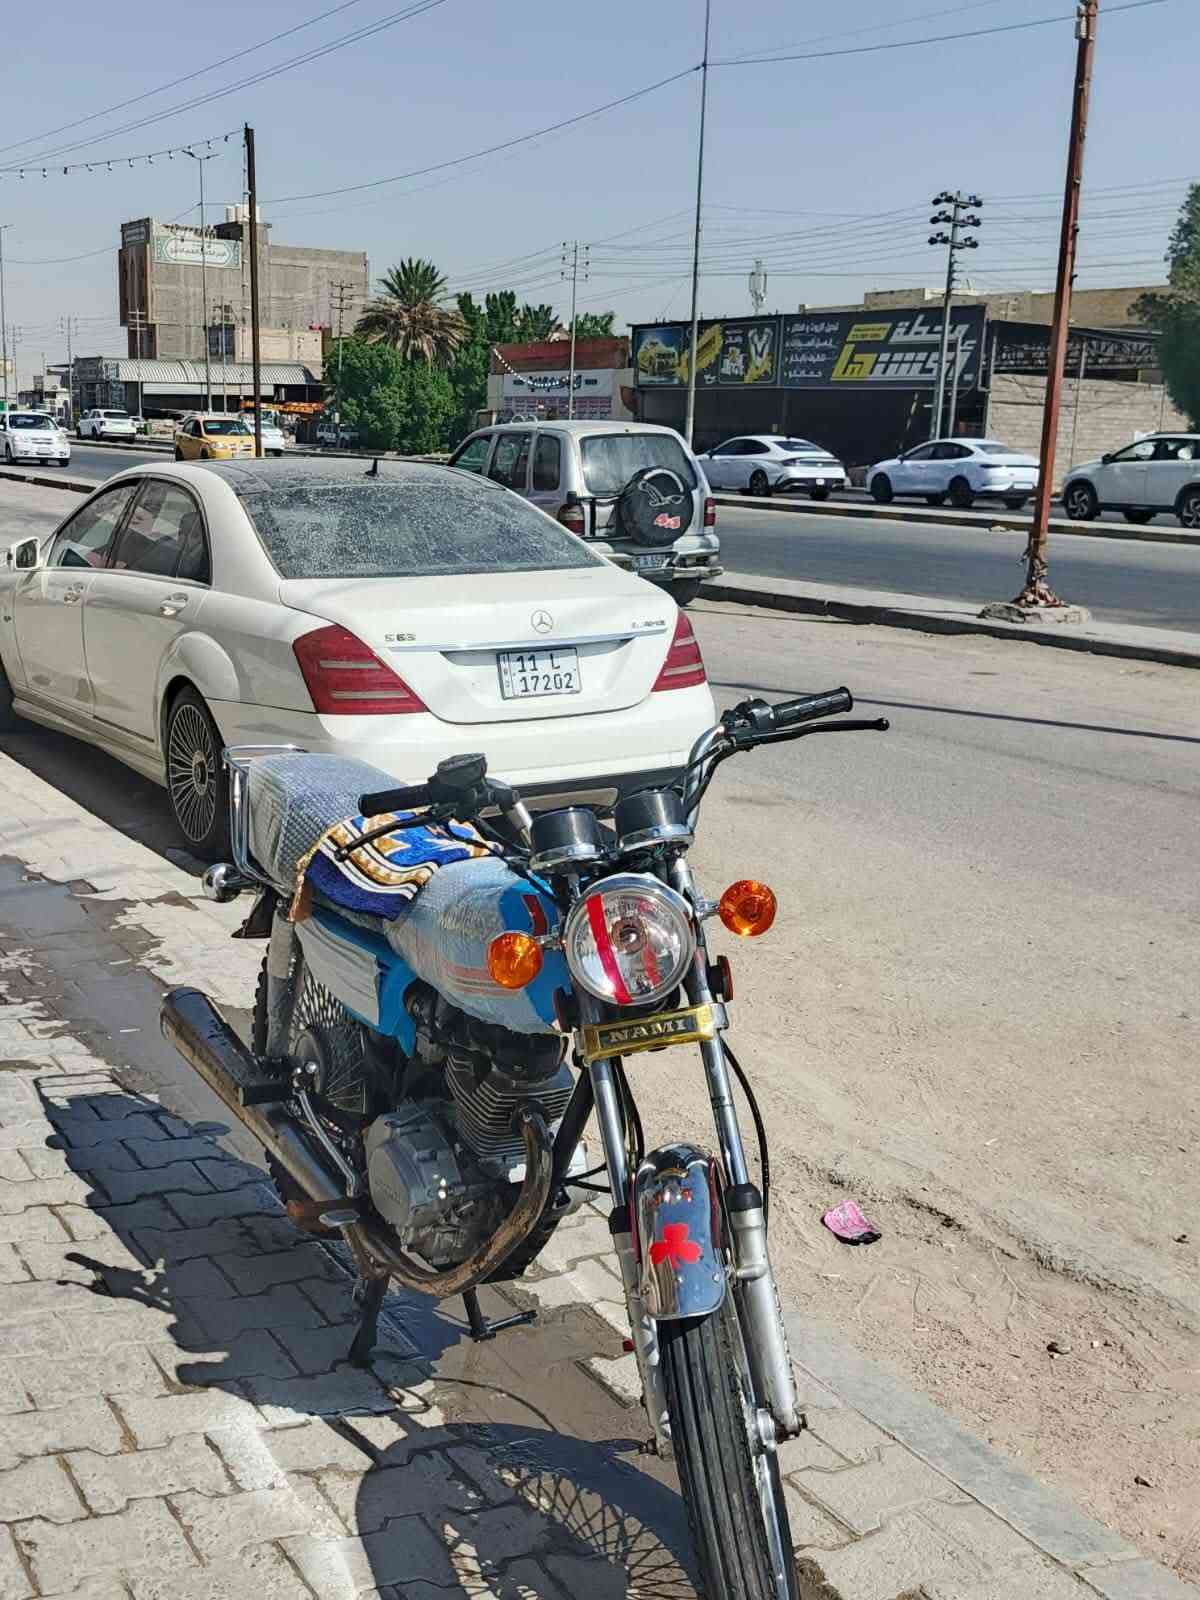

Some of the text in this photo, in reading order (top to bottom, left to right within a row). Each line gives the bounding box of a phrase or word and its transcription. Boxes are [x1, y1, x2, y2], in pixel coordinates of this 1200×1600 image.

[516, 653, 561, 672] 11 L
[520, 672, 573, 692] 17202
[608, 1018, 687, 1043] NAMI
